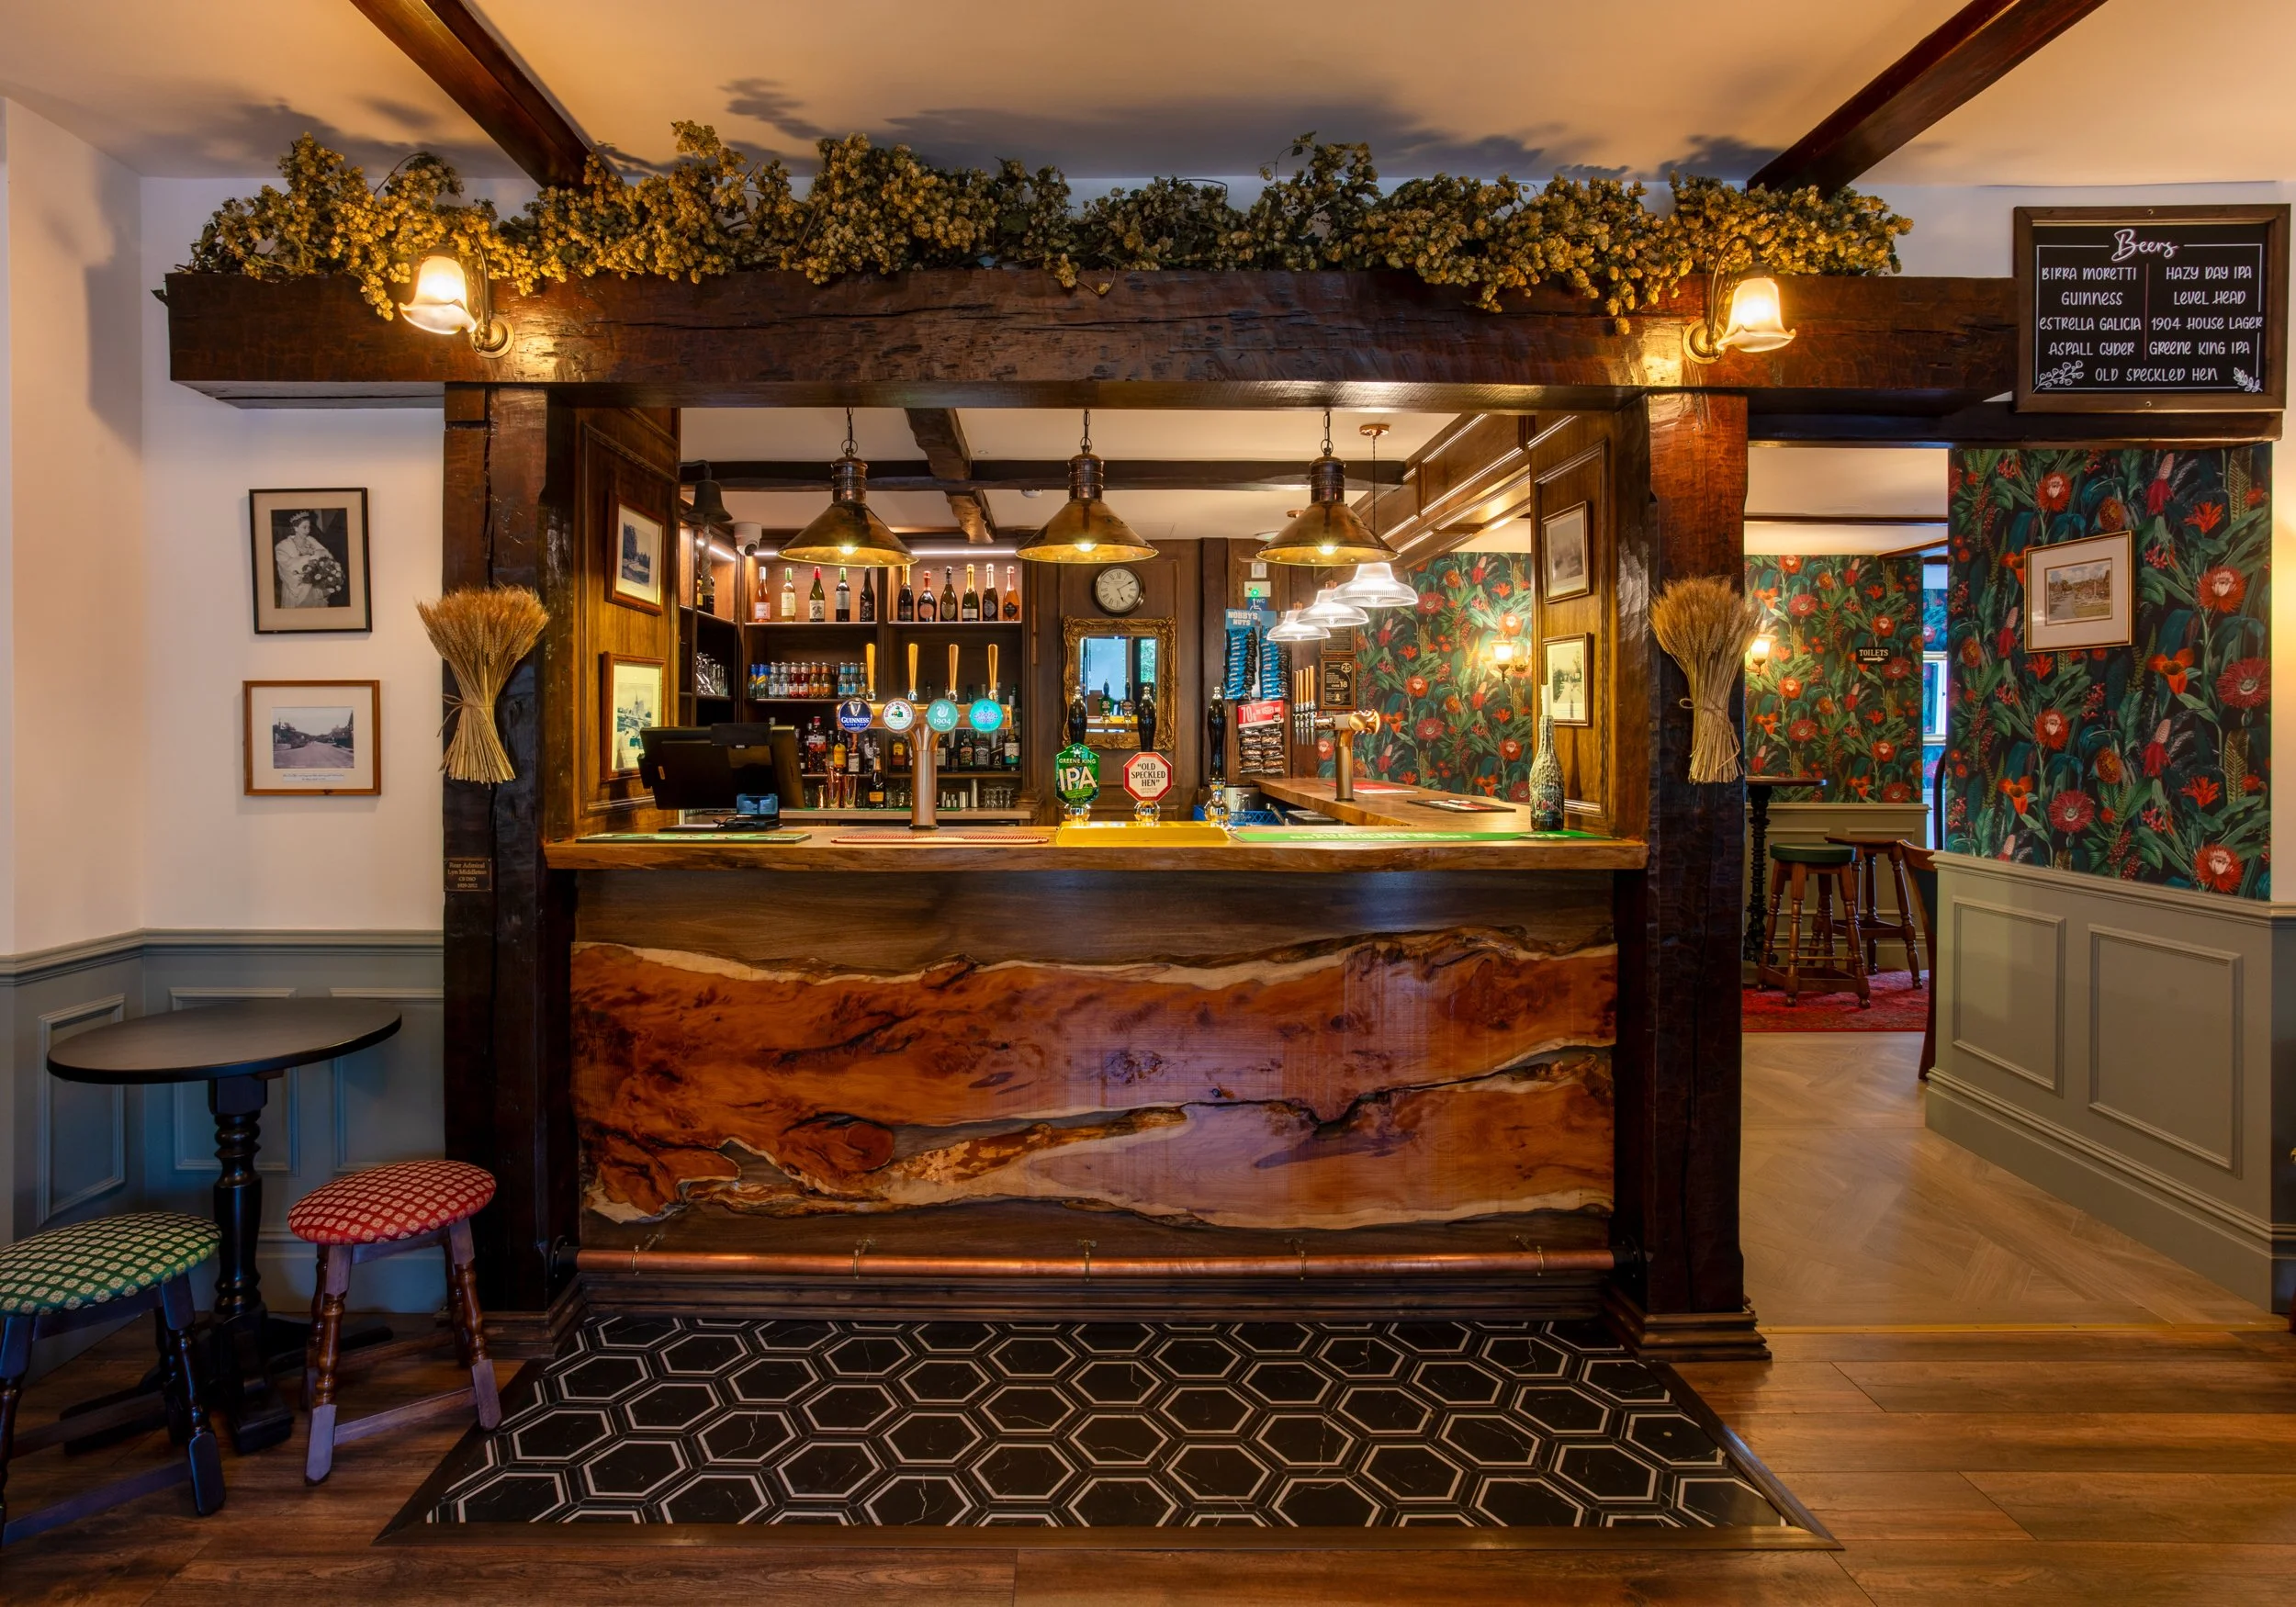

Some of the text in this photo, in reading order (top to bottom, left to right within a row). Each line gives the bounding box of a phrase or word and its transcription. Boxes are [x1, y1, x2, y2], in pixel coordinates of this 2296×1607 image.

[2111, 229, 2178, 262] Beers
[2042, 266, 2137, 281] BIRRA MORETTI
[2166, 265, 2253, 280] HAZY DAY IPA
[2061, 291, 2123, 306] GUINNESS
[2174, 290, 2246, 305] LEVEL HEAD
[2039, 317, 2142, 331] ESTRELLA GALICIA
[2151, 316, 2263, 331] 1904 HOUSE LAGER
[2048, 342, 2135, 356] ASPALL CYDER
[2149, 341, 2251, 355] GREENE KING IPA
[2095, 367, 2219, 382] OLD SPECKLED HEN
[1228, 611, 1258, 620] NOBBY'S
[1859, 648, 1889, 657] TOILETS
[1059, 766, 1097, 792] IPA
[1131, 770, 1166, 780] SPECKLED
